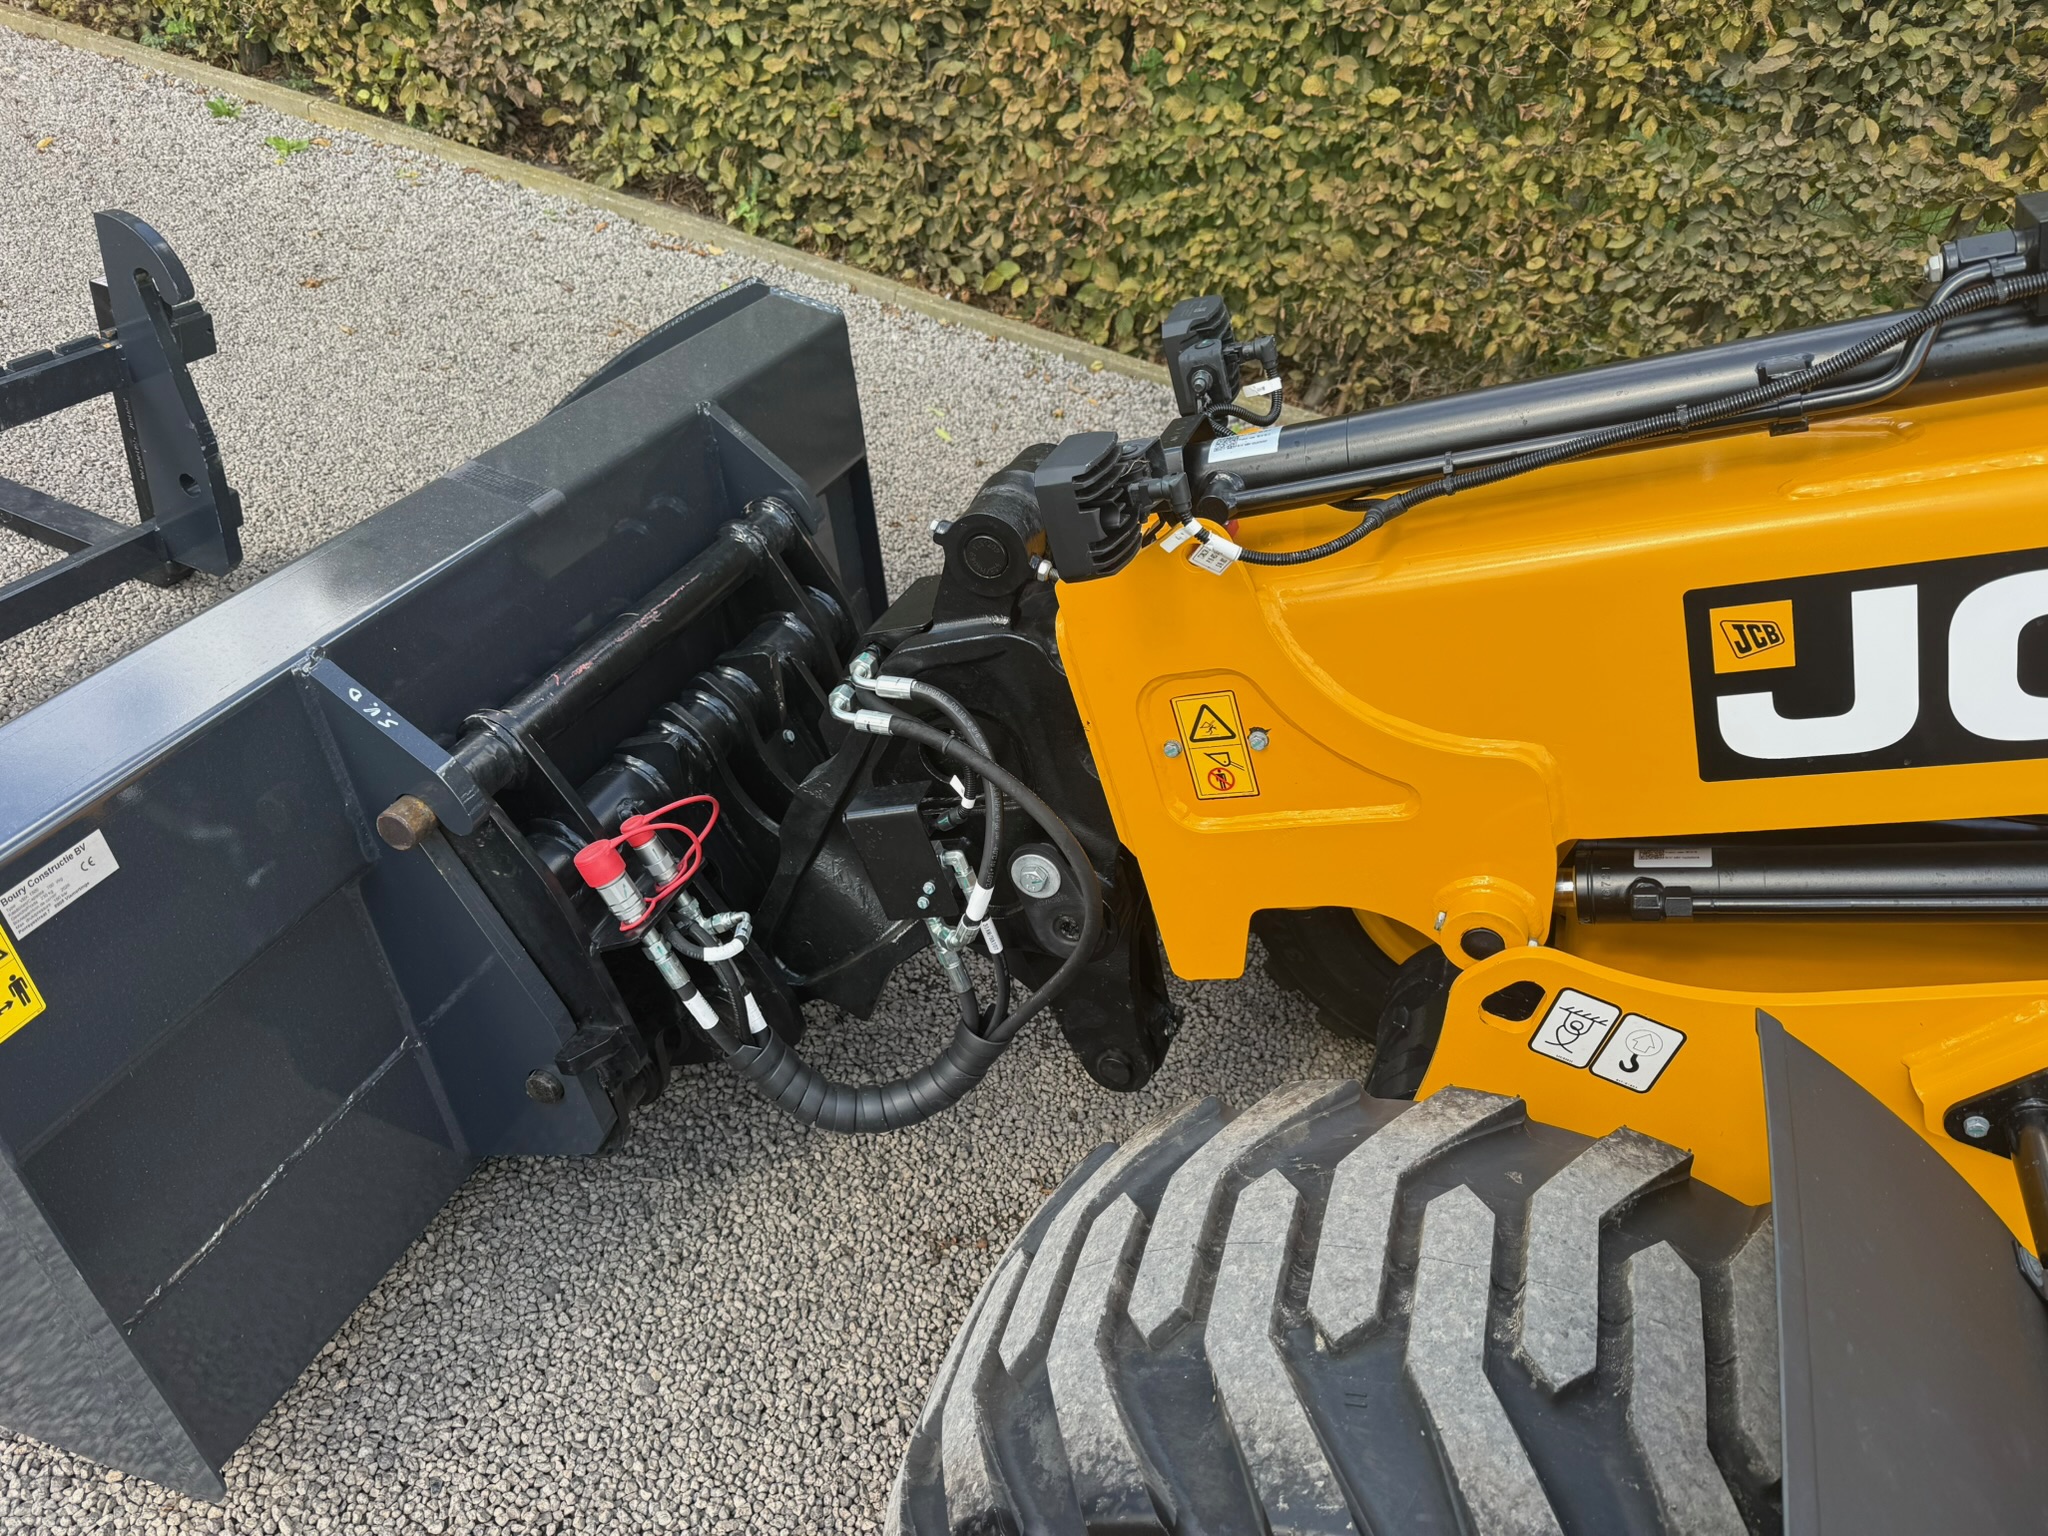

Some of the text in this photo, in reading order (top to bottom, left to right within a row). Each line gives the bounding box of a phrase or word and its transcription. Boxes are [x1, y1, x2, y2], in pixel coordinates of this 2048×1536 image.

[1732, 623, 1781, 655] JCB
[0, 885, 26, 908] Boury
[28, 852, 74, 888] Constructie
[74, 842, 87, 856] BV
